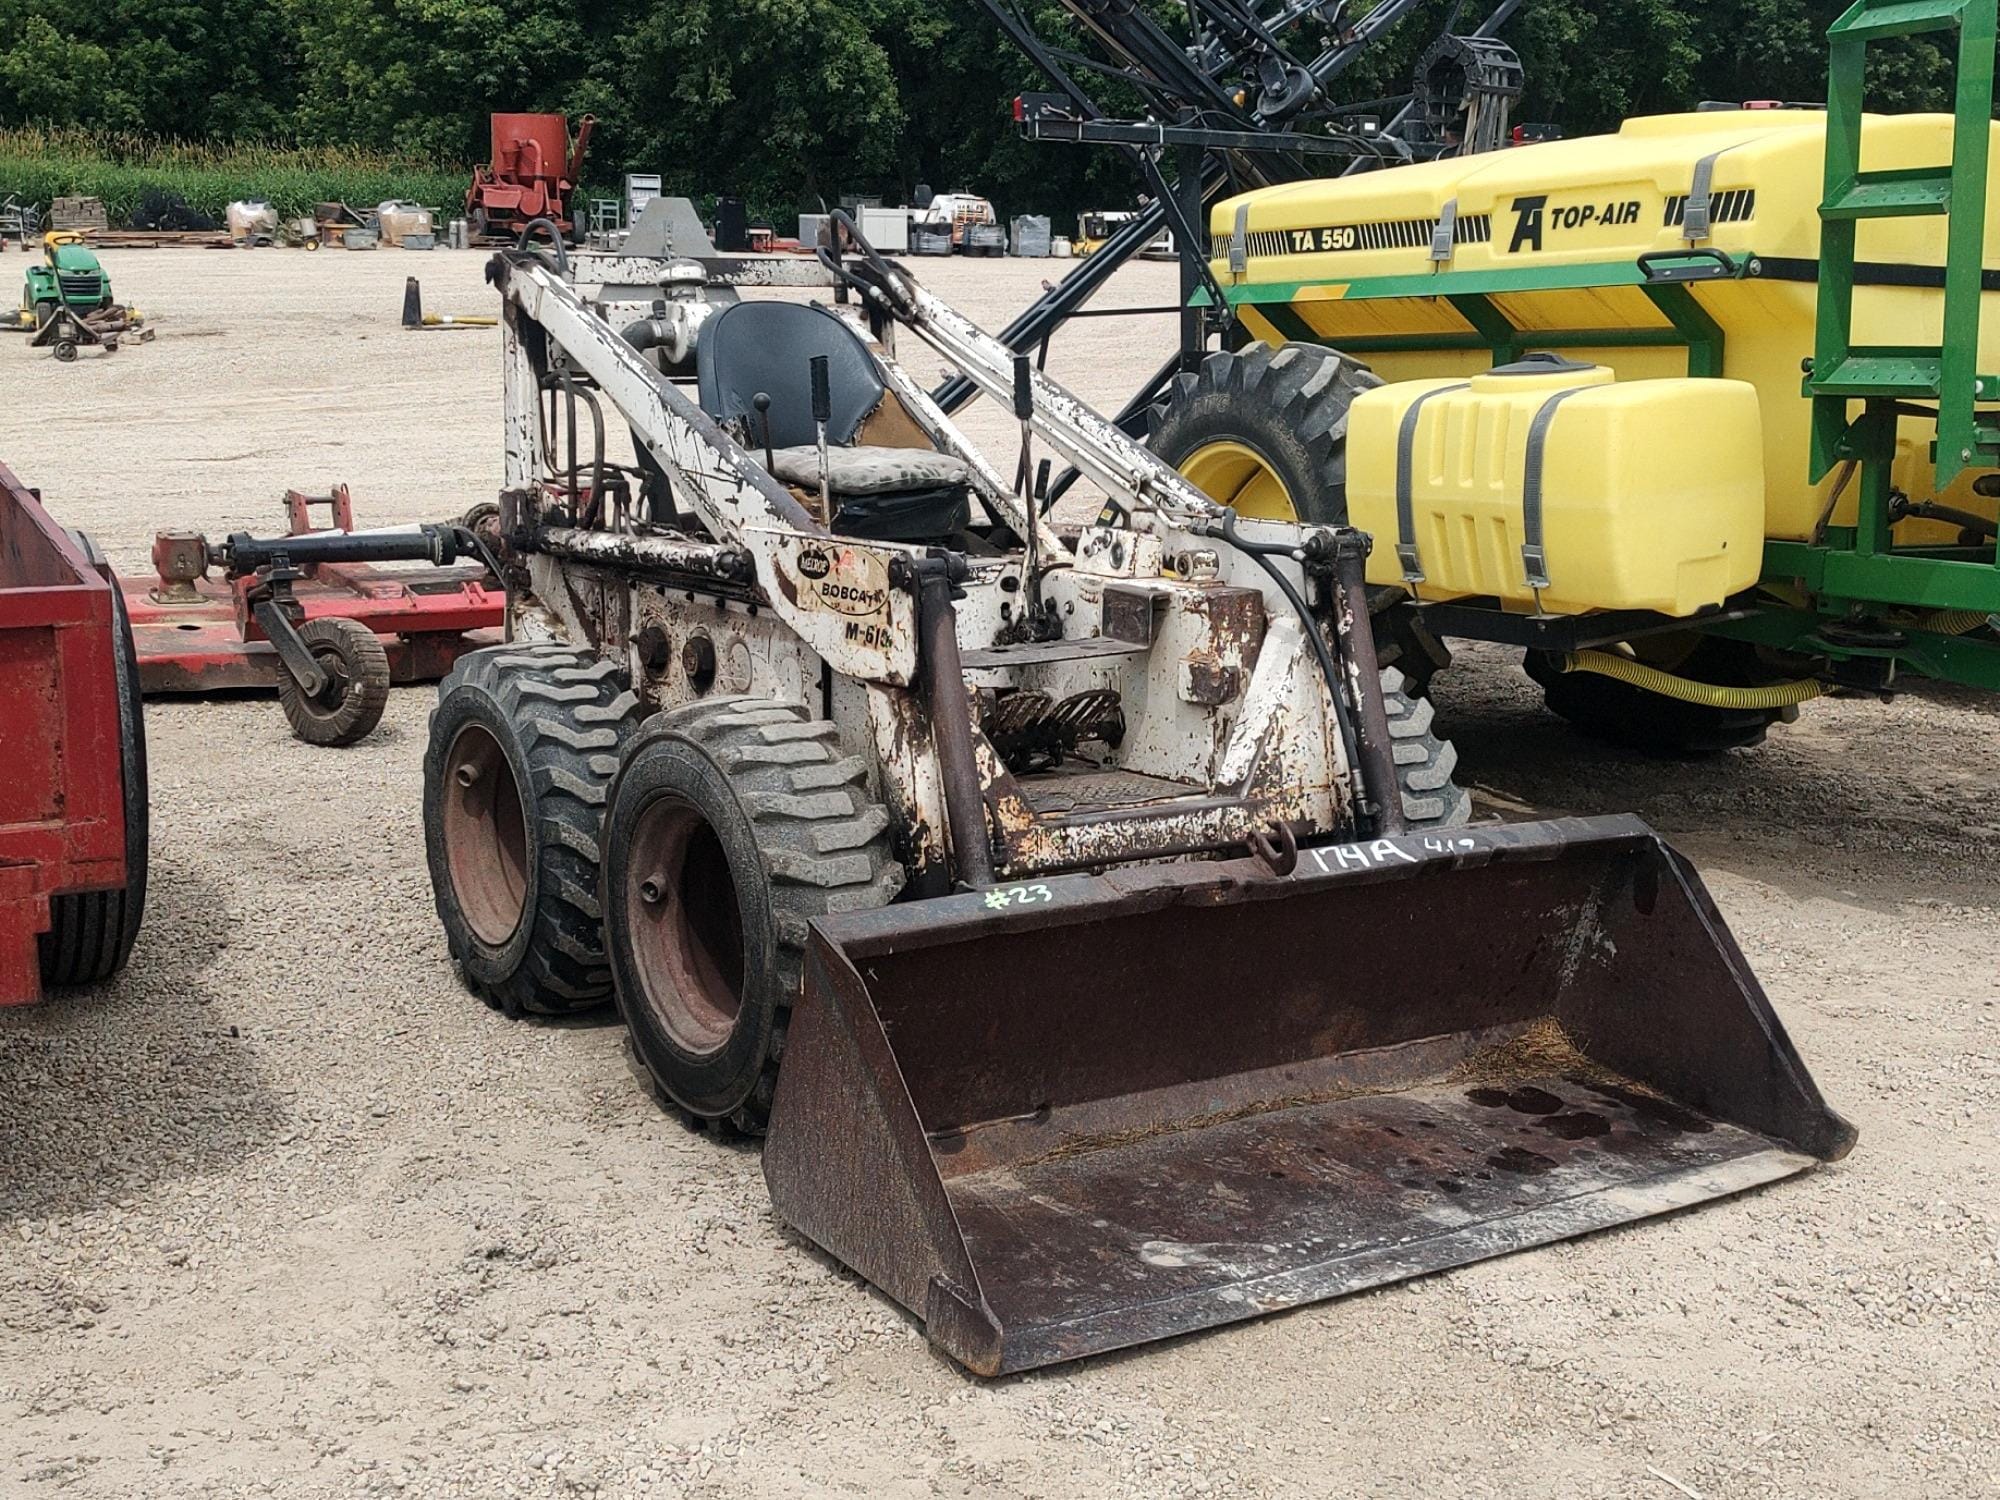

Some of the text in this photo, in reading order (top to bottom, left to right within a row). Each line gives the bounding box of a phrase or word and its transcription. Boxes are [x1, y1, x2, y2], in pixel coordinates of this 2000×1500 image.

[1551, 200, 1642, 230] TOP-AIR
[1292, 227, 1356, 252] TA 550
[821, 582, 875, 607] BOBCAT
[1311, 839, 1419, 872] 174A
[984, 884, 1053, 910] #23
